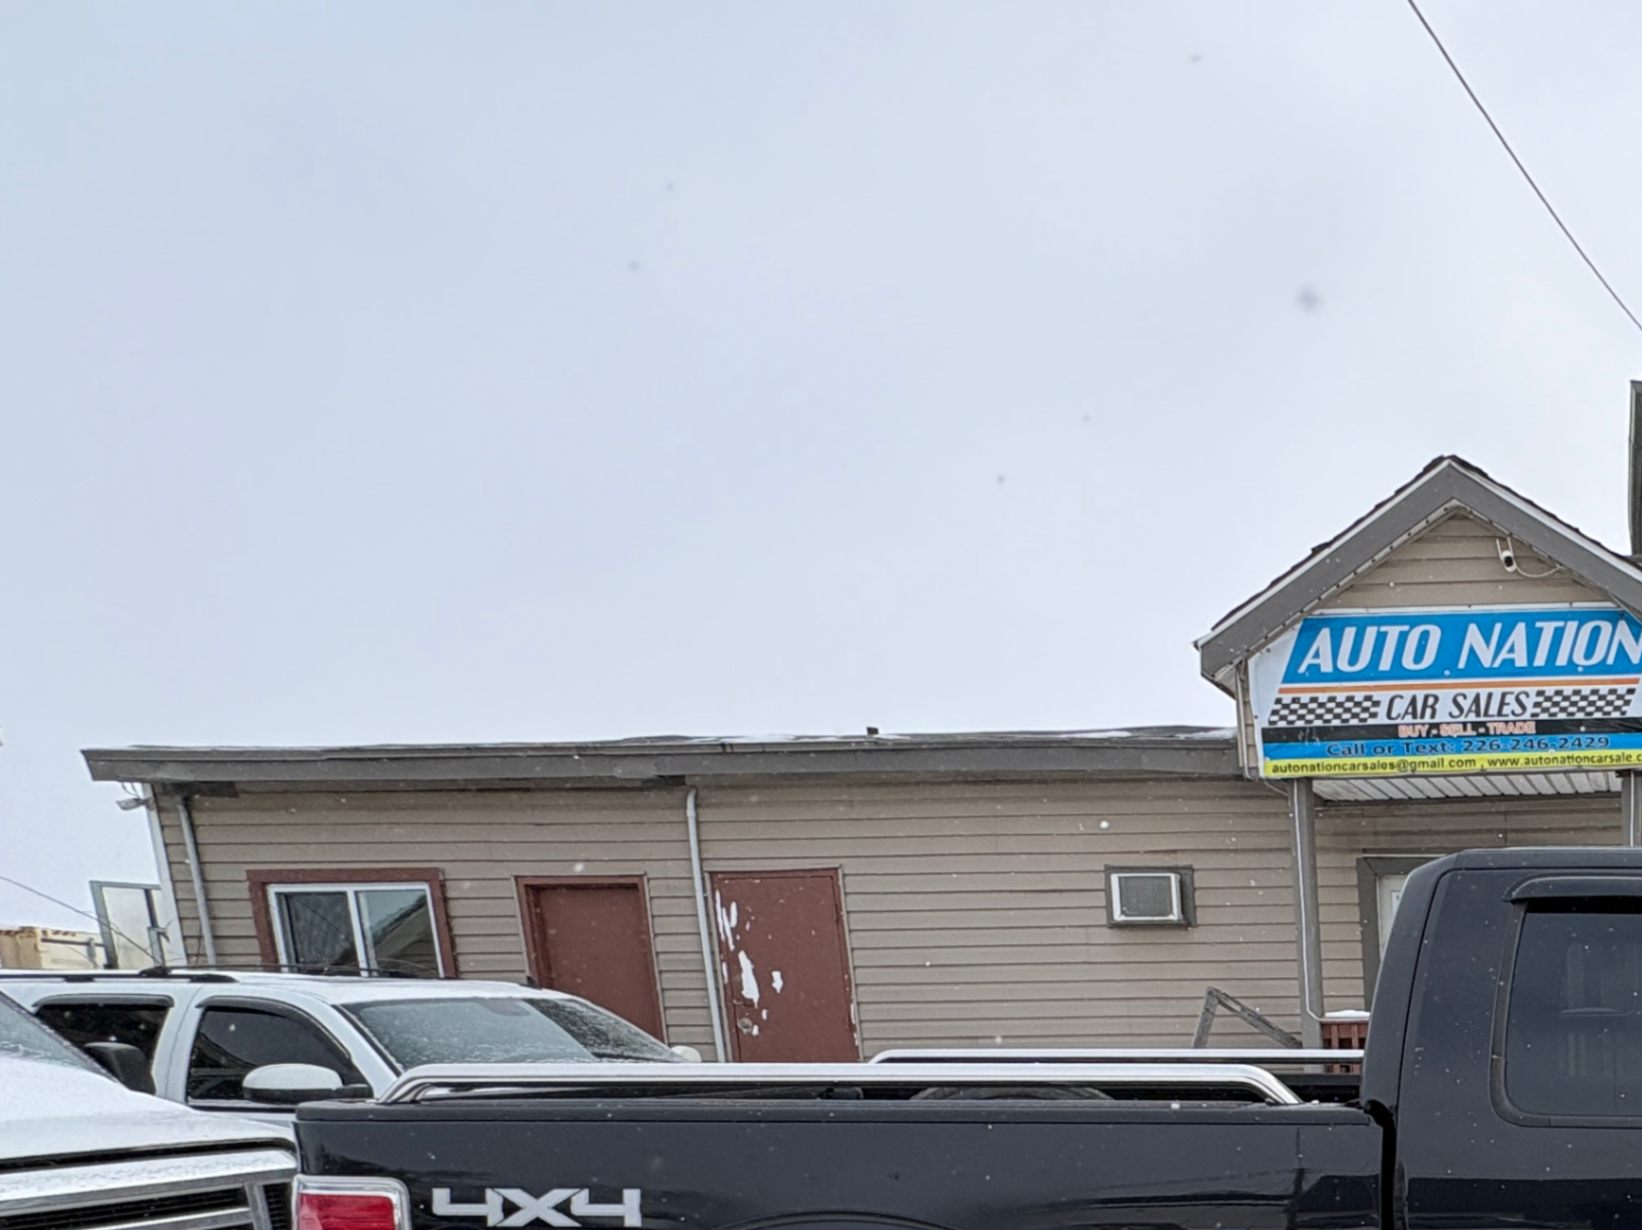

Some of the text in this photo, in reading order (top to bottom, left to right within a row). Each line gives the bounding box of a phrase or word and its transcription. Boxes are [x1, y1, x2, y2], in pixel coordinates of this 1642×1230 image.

[1297, 624, 1442, 674] AUTO
[1386, 691, 1529, 720] CAR SALES
[1398, 723, 1429, 738] BUY
[1439, 722, 1476, 737] SELL
[1486, 721, 1536, 735] TRADE
[1327, 743, 1364, 756] Call
[1373, 745, 1393, 755] or
[1403, 741, 1453, 754] Text:
[1272, 757, 1476, 774] autonationcarsales@gmail.com
